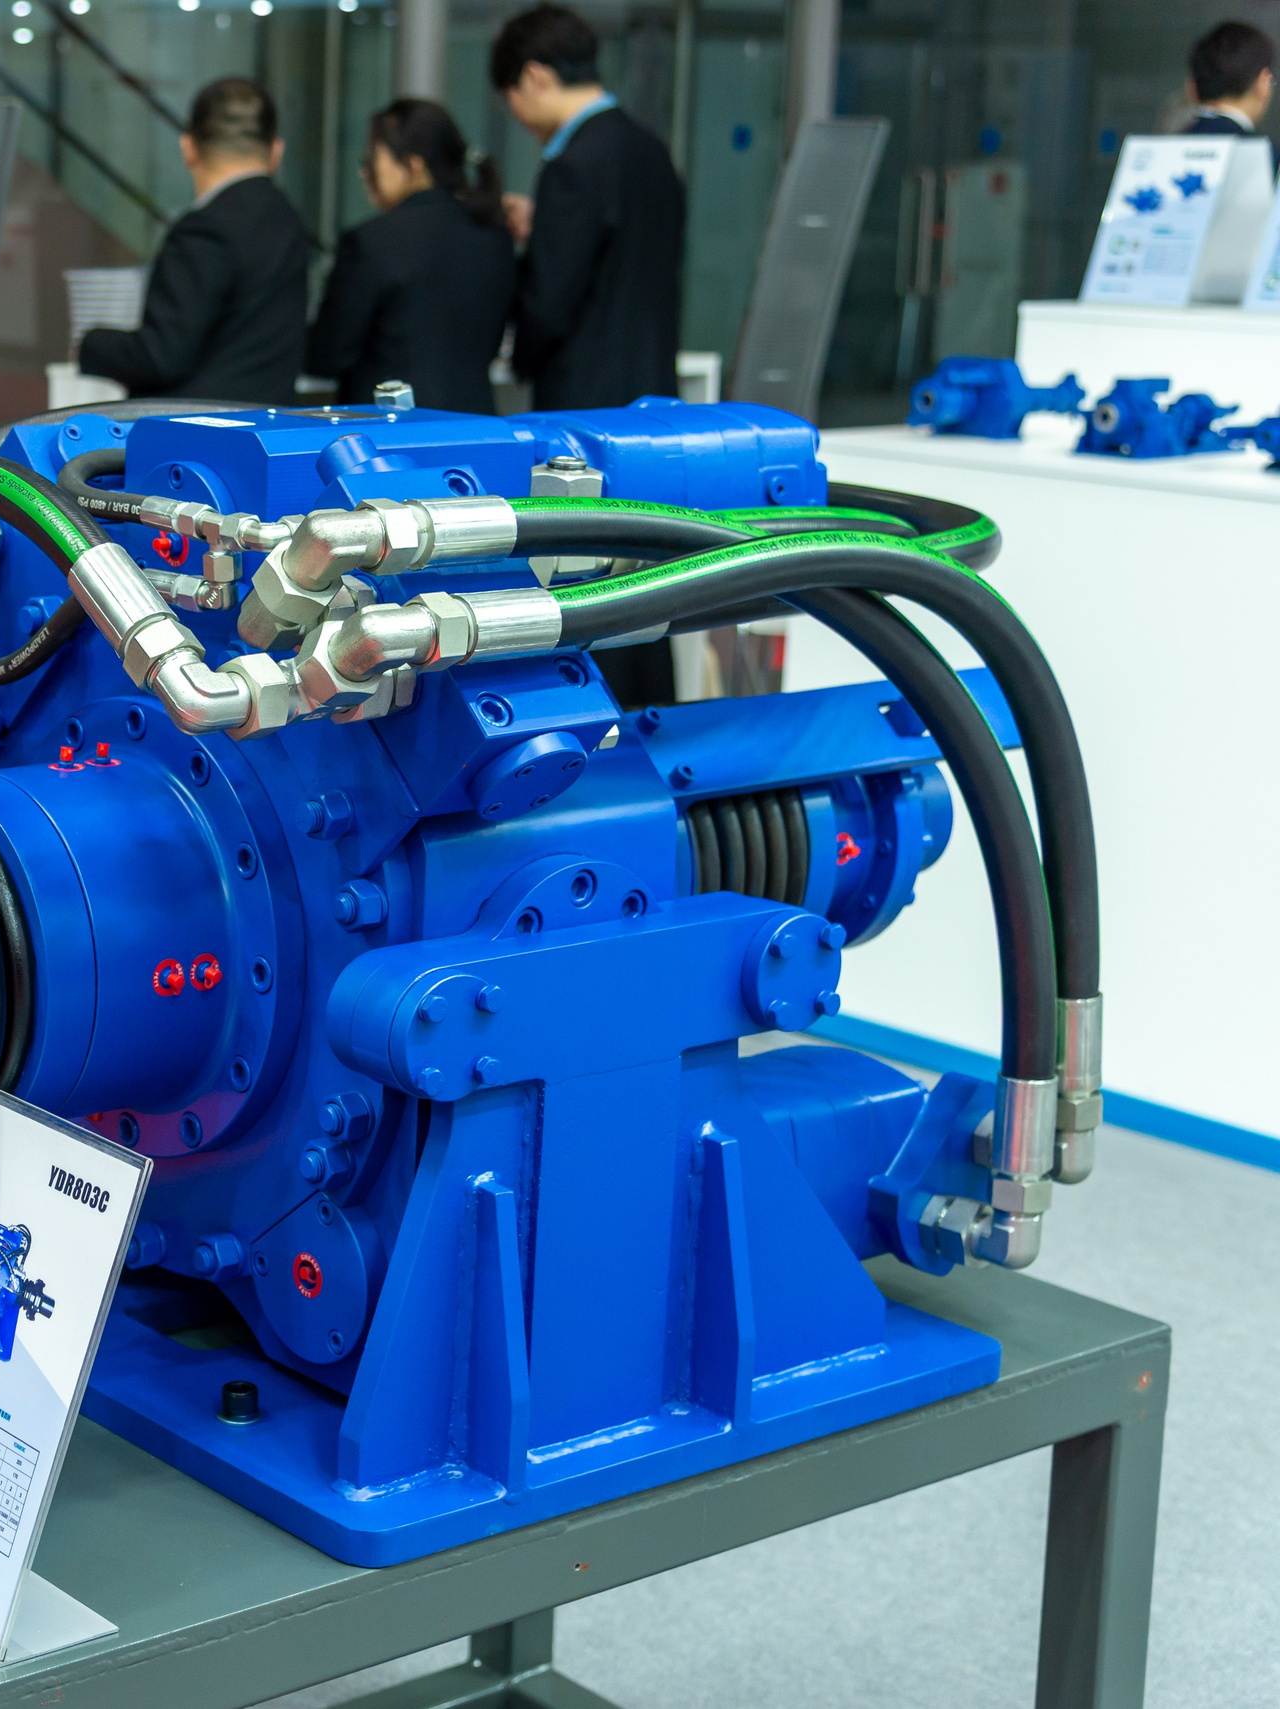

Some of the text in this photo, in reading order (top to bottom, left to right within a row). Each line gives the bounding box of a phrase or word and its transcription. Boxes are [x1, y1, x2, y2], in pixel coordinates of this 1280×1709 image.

[6, 478, 36, 502] exceeds
[77, 496, 90, 508] PSI
[90, 498, 107, 510] 4800
[112, 502, 130, 514] BAR
[778, 536, 813, 549] (5000
[813, 533, 843, 544] MPa
[862, 534, 884, 544] WP
[752, 540, 779, 554] PSI)
[726, 548, 744, 559] ISO
[680, 554, 725, 572] 18752/CC
[636, 566, 674, 582] exceeds
[597, 582, 615, 594] 100
[616, 576, 636, 588] SAE
[555, 591, 572, 600] EN
[578, 586, 597, 597] R13
[48, 1164, 110, 1213] YDR803C
[300, 1254, 320, 1272] GREASE
